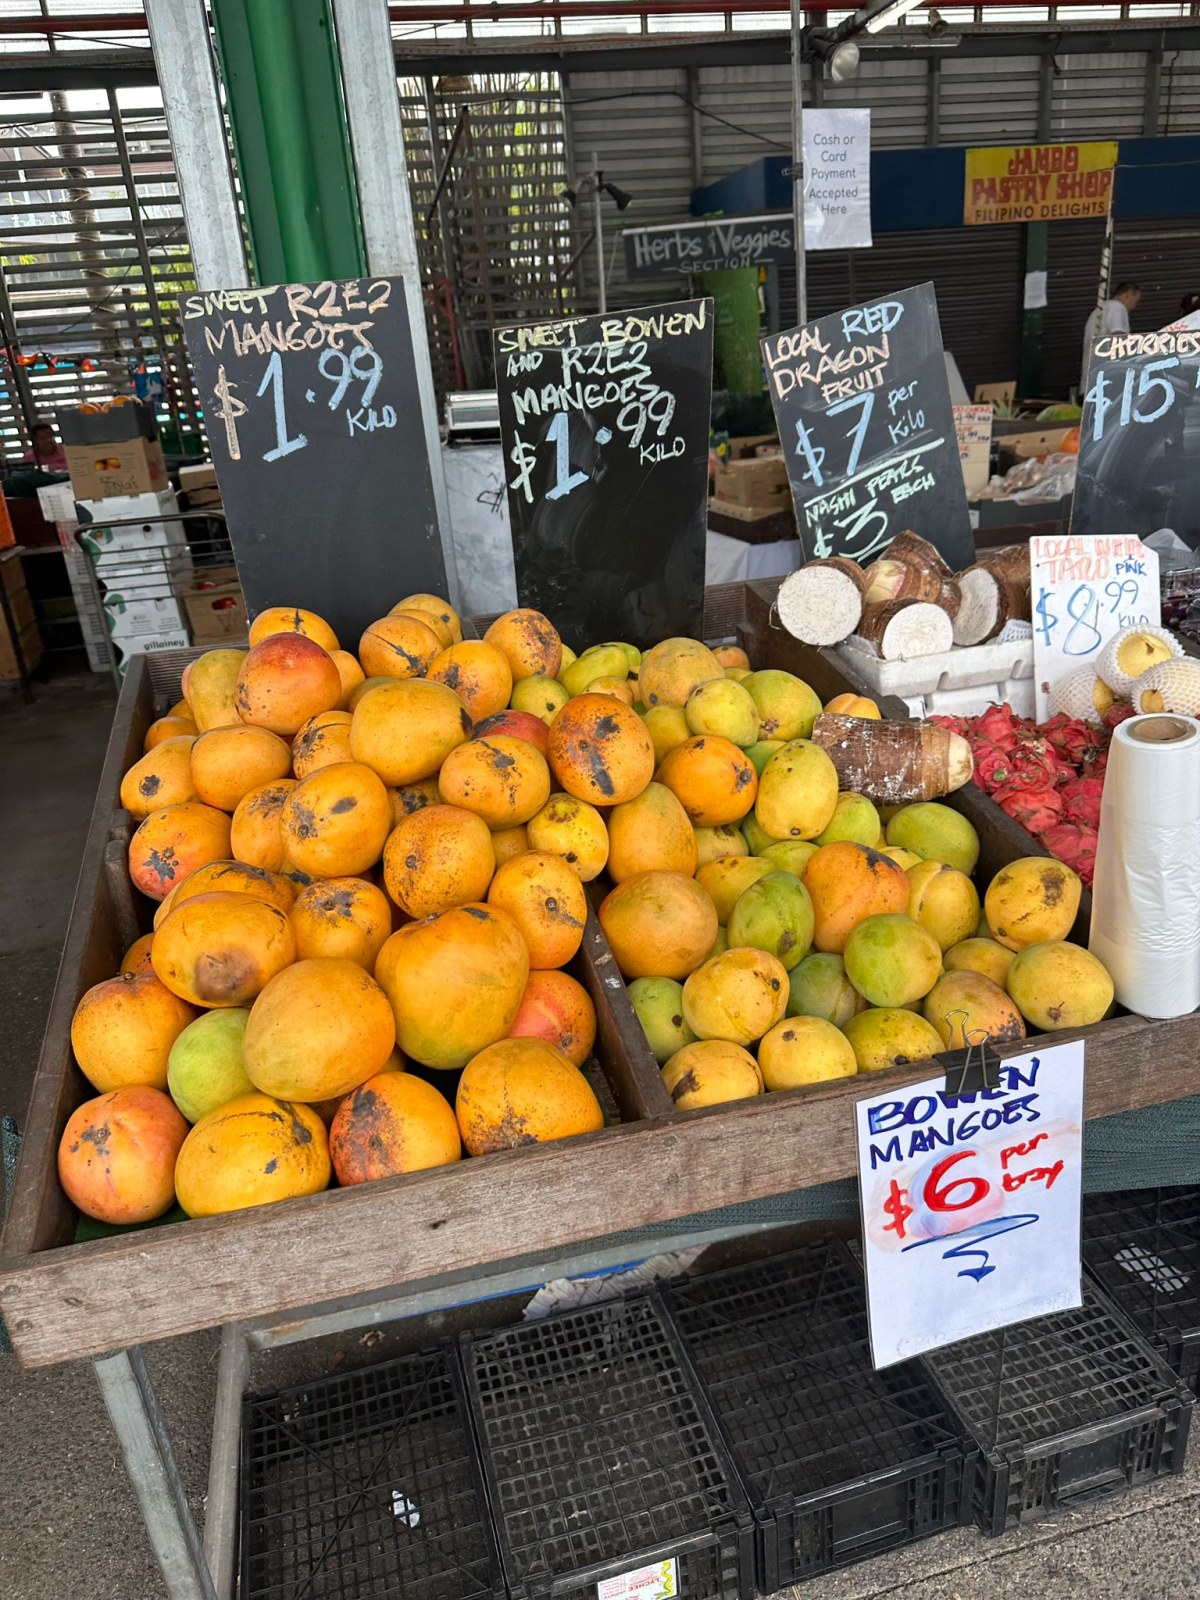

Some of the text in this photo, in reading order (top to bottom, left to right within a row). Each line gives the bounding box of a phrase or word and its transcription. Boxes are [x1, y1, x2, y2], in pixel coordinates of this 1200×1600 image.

[813, 133, 855, 145] Cash or
[821, 150, 847, 162] Card
[1008, 145, 1079, 175] JAMBO
[811, 168, 856, 181] Payment
[972, 170, 1112, 205] PASTRY SHOP
[809, 186, 858, 200] Accepted
[821, 203, 847, 214] Here
[975, 201, 1105, 222] FILIPINO DELIGHTS
[633, 230, 702, 268] Herbs
[715, 224, 792, 258] Veggies
[678, 256, 750, 274] SECTION
[185, 279, 392, 321] SWEET R2E2
[204, 319, 375, 357] MANGOES
[499, 300, 706, 352] SWEET BOWEN
[764, 301, 905, 370] LOCAL RED
[506, 341, 651, 390] AND R2E2
[773, 333, 890, 400] DRAGON
[511, 371, 660, 425] MANGOES
[821, 362, 889, 404] FRUIT
[888, 380, 918, 416] per
[346, 405, 398, 437] KILO
[640, 436, 686, 465] KILO
[805, 454, 925, 528] NASHI PEARS
[890, 471, 936, 504] EACH
[1033, 537, 1088, 558] LOCAL
[1116, 560, 1147, 576] PINK
[869, 1092, 1041, 1170] MANGOES
[1000, 1132, 1049, 1169] per
[1002, 1159, 1064, 1192] tray
[629, 1578, 660, 1591] LYCHEE
